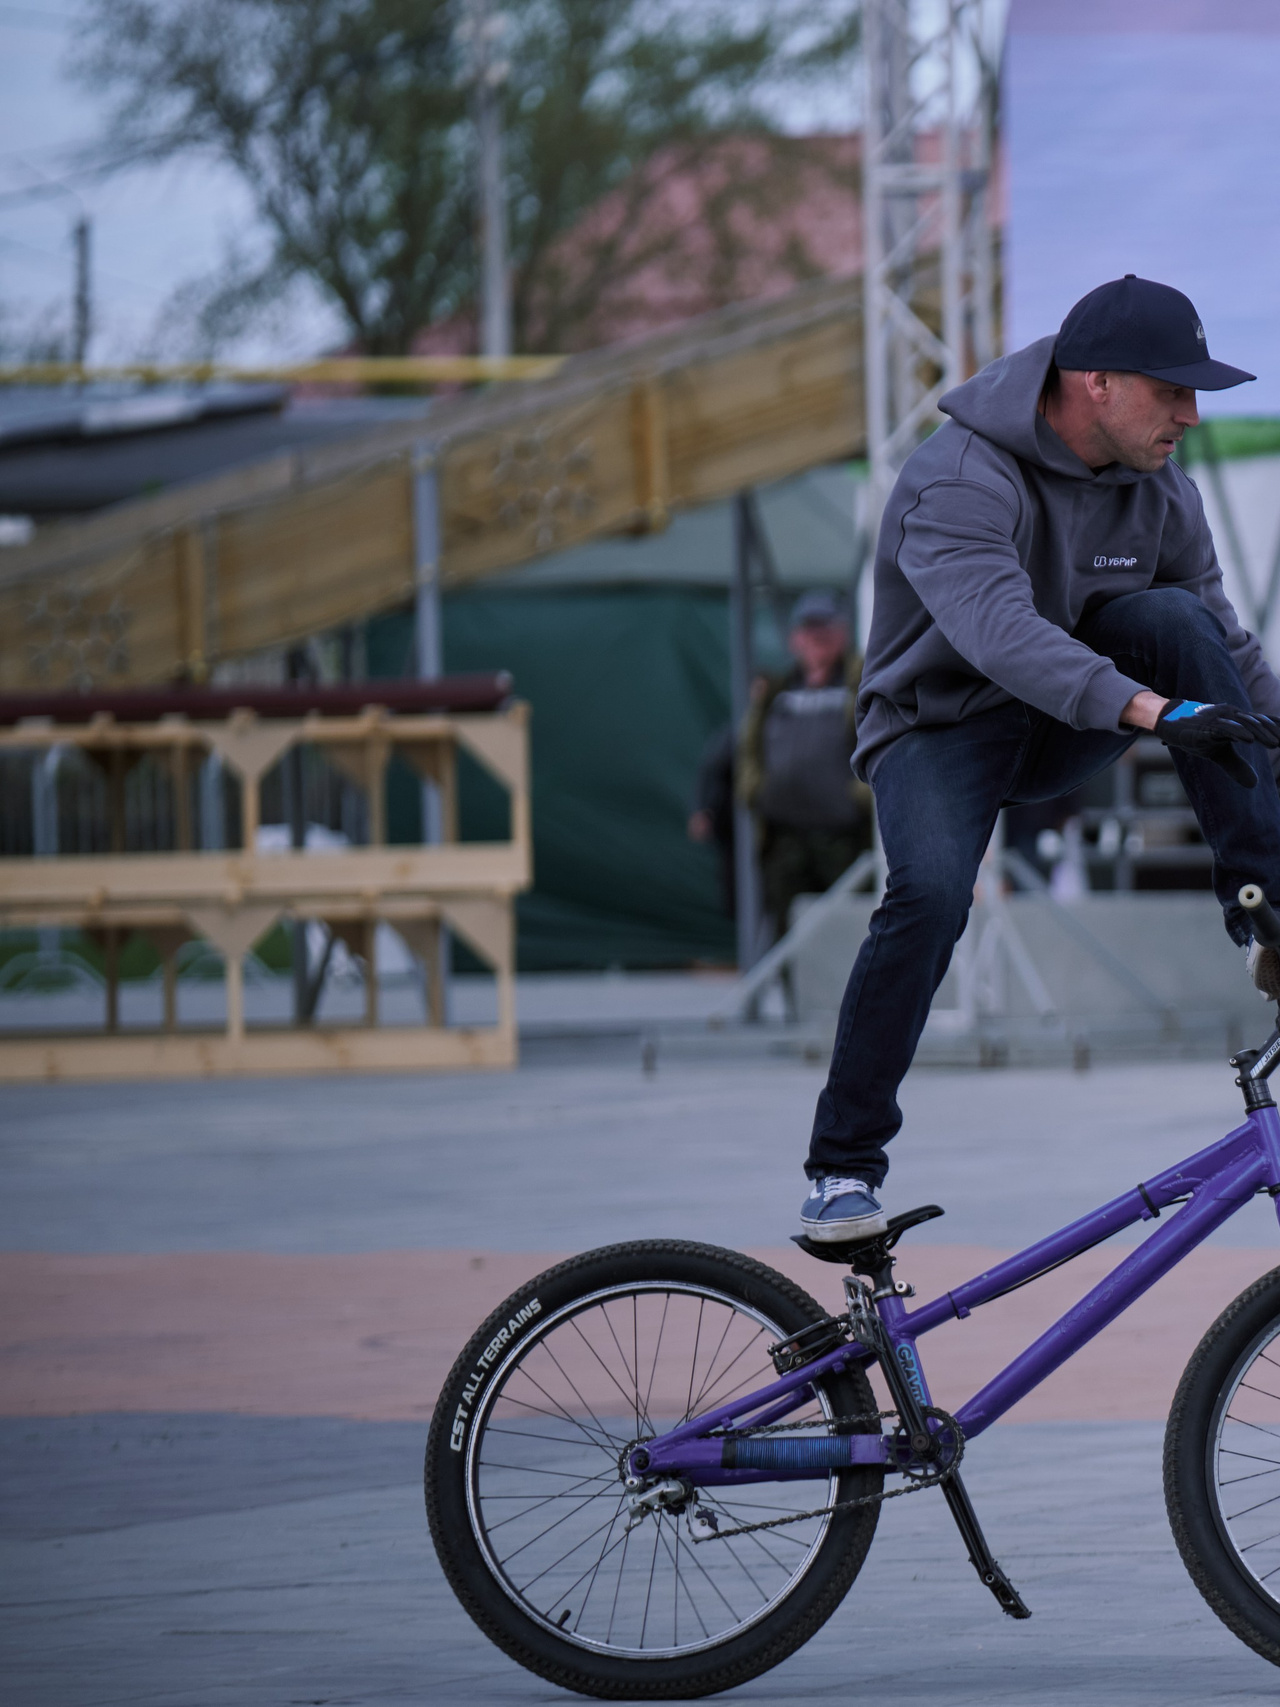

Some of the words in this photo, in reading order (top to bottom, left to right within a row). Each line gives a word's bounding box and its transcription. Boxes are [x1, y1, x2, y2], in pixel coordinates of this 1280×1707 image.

[450, 1404, 469, 1452] CST
[462, 1372, 485, 1405] ALL
[477, 1298, 542, 1370] TERRAINS
